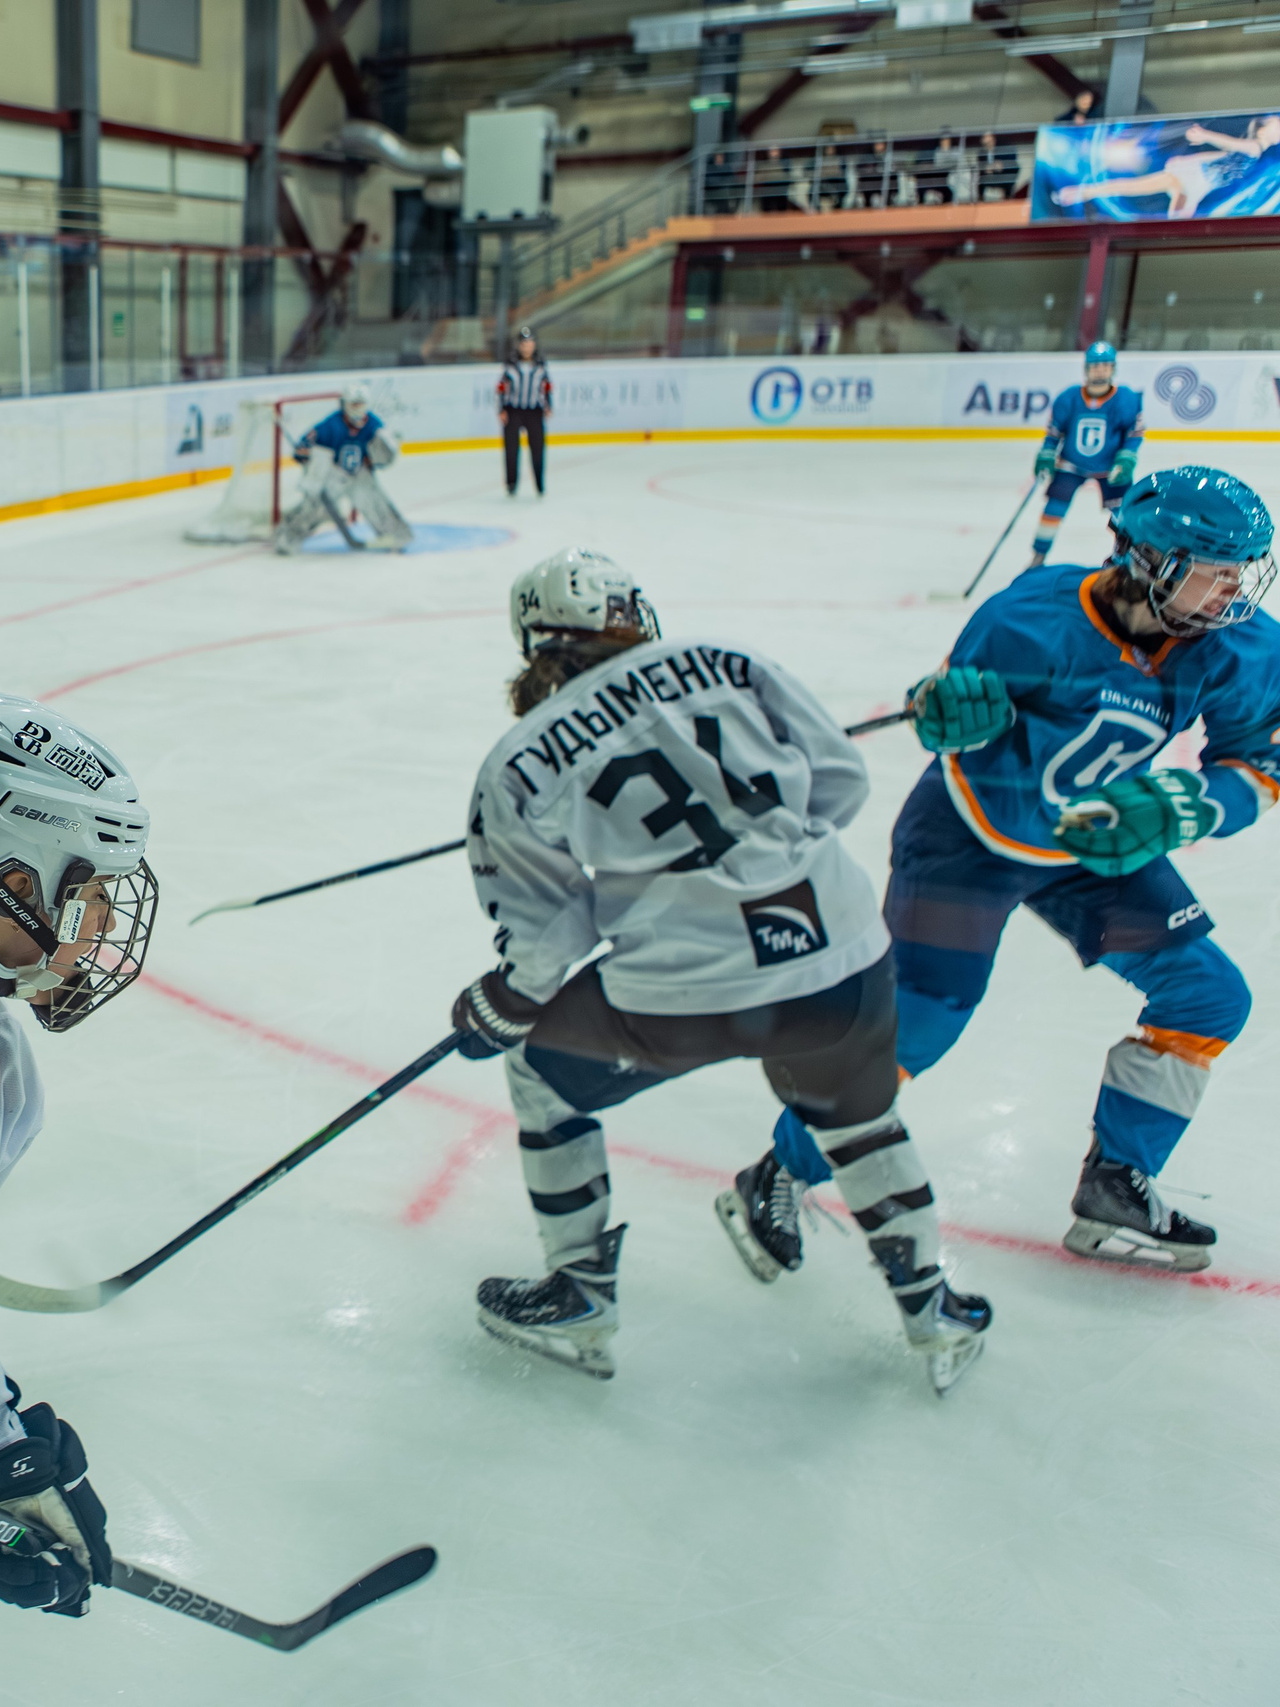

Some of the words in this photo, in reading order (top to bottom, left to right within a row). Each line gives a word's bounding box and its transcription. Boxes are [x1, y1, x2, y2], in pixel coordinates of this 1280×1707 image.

[506, 645, 753, 796] ГУДЫМЕНКО
[587, 715, 786, 873] 34
[10, 804, 82, 832] BAUER
[70, 906, 81, 940] BAUER
[1167, 902, 1204, 931] CC
[757, 926, 811, 954] ТМК
